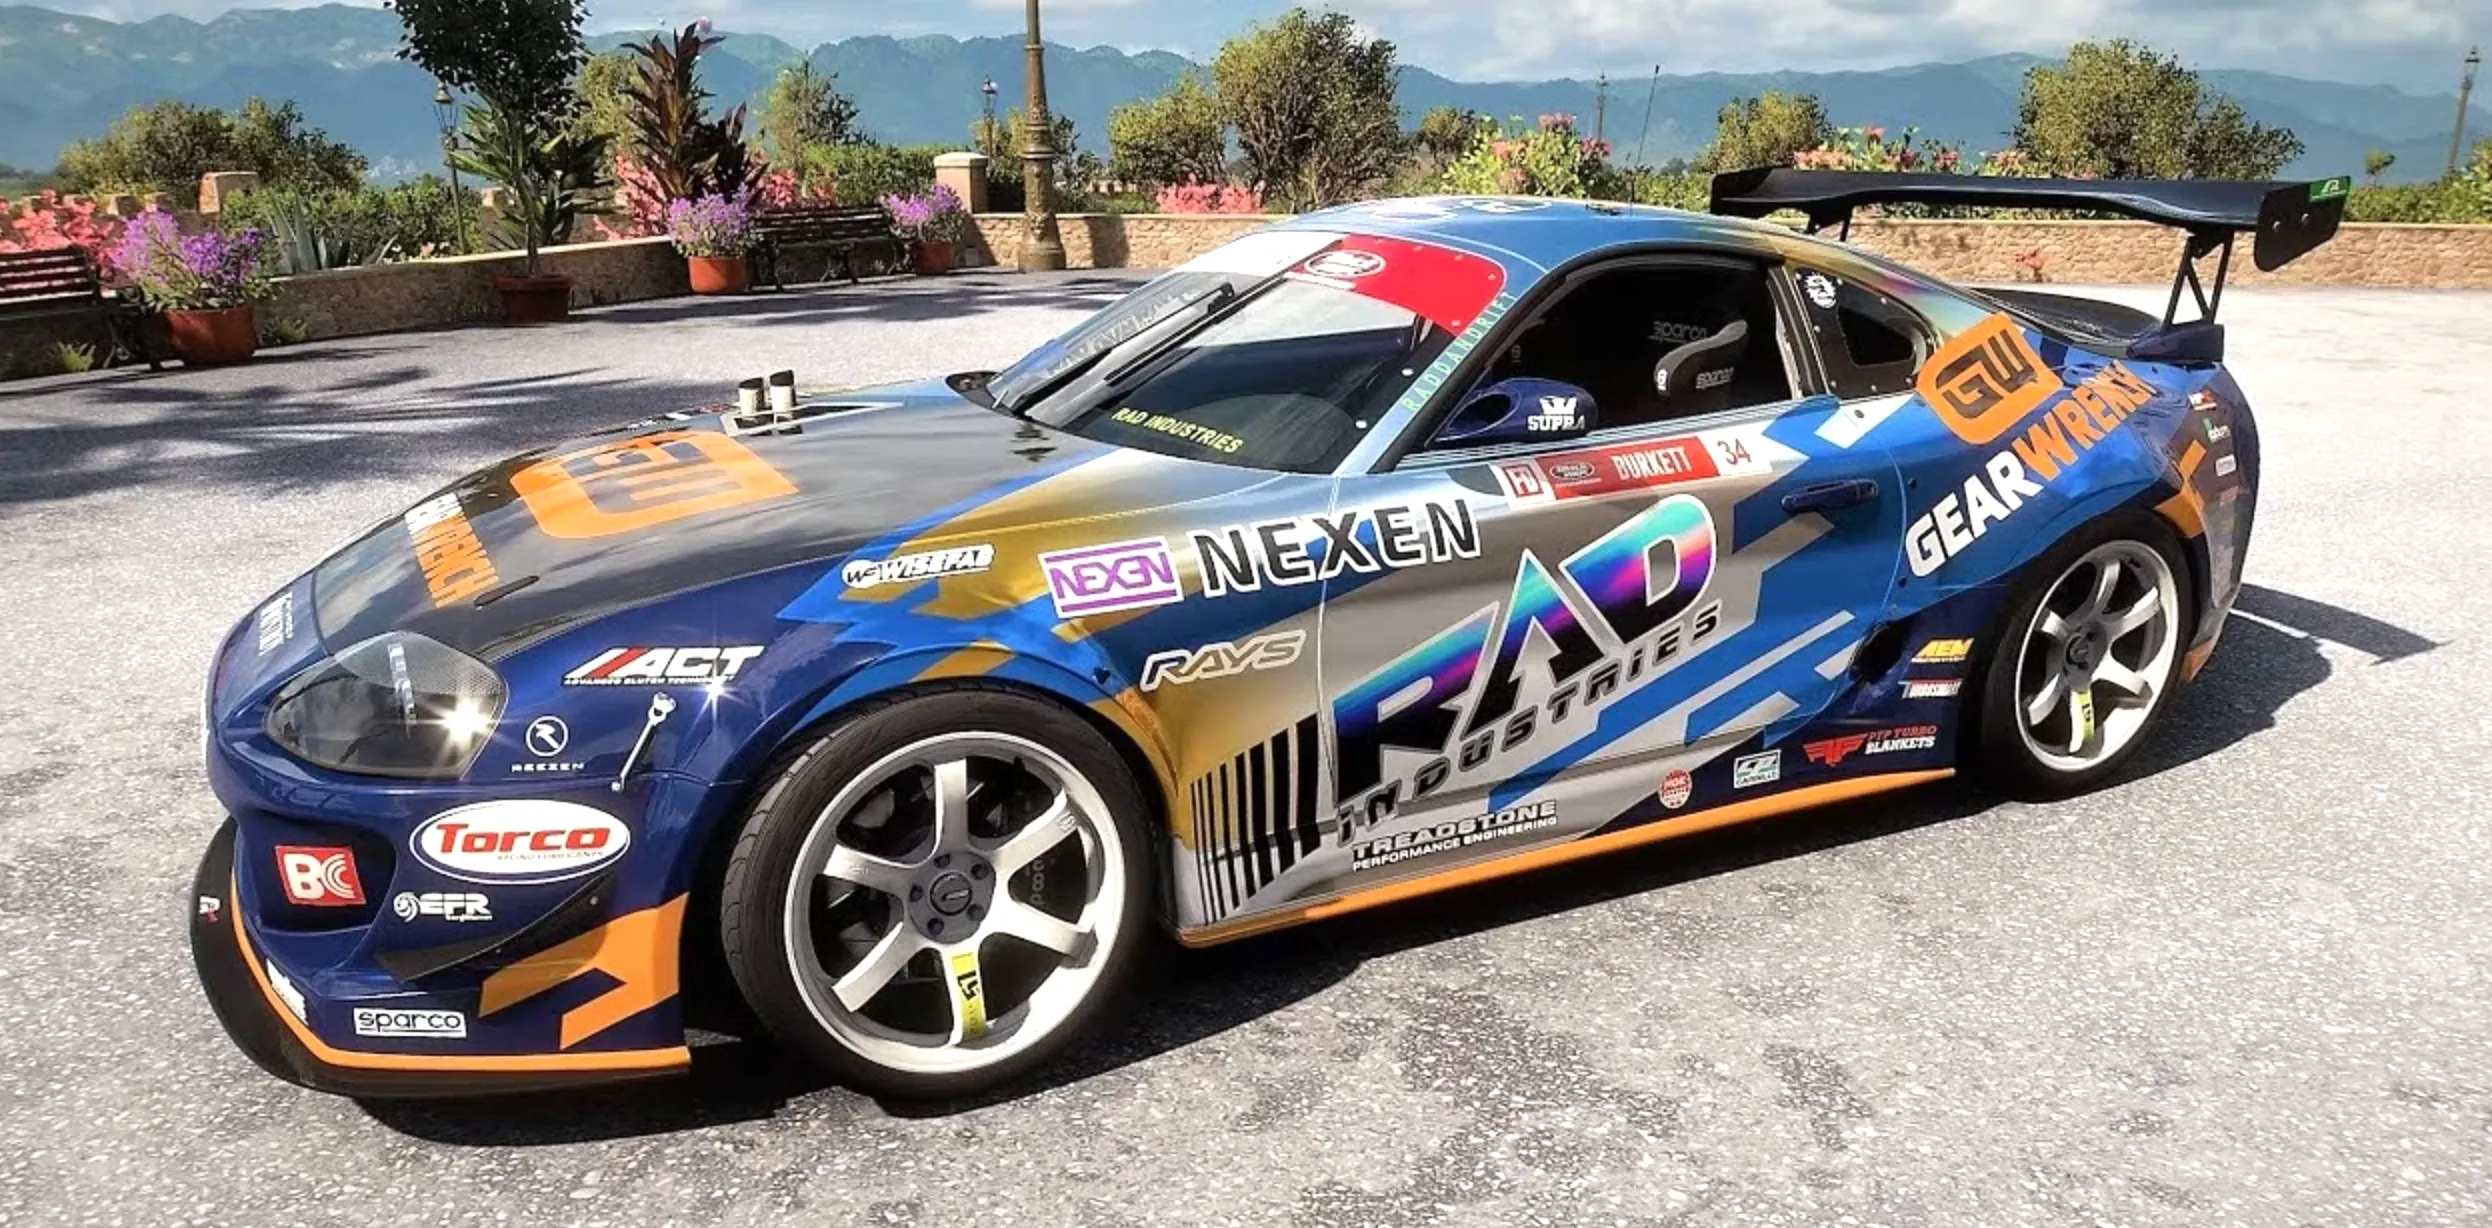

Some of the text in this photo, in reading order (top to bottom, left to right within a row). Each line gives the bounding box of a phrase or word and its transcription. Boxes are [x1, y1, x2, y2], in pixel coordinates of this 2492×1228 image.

[1111, 407, 1244, 453] RAD INDUSTRIES
[1527, 415, 1585, 431] SUPRA
[1611, 446, 1693, 481] BURKETT
[1717, 438, 1752, 466] 34
[1191, 498, 1478, 594] NEXEN
[1049, 551, 1176, 600] NEXEN
[604, 646, 766, 679] ACT
[1141, 631, 1303, 690] RAYS
[1333, 494, 1717, 804] RAD
[436, 823, 611, 854] Torco
[1352, 815, 1558, 872] PERFORMANCE ENGINEERING
[1353, 799, 1558, 859] TREADSTONE
[358, 1010, 462, 1033] sparco
